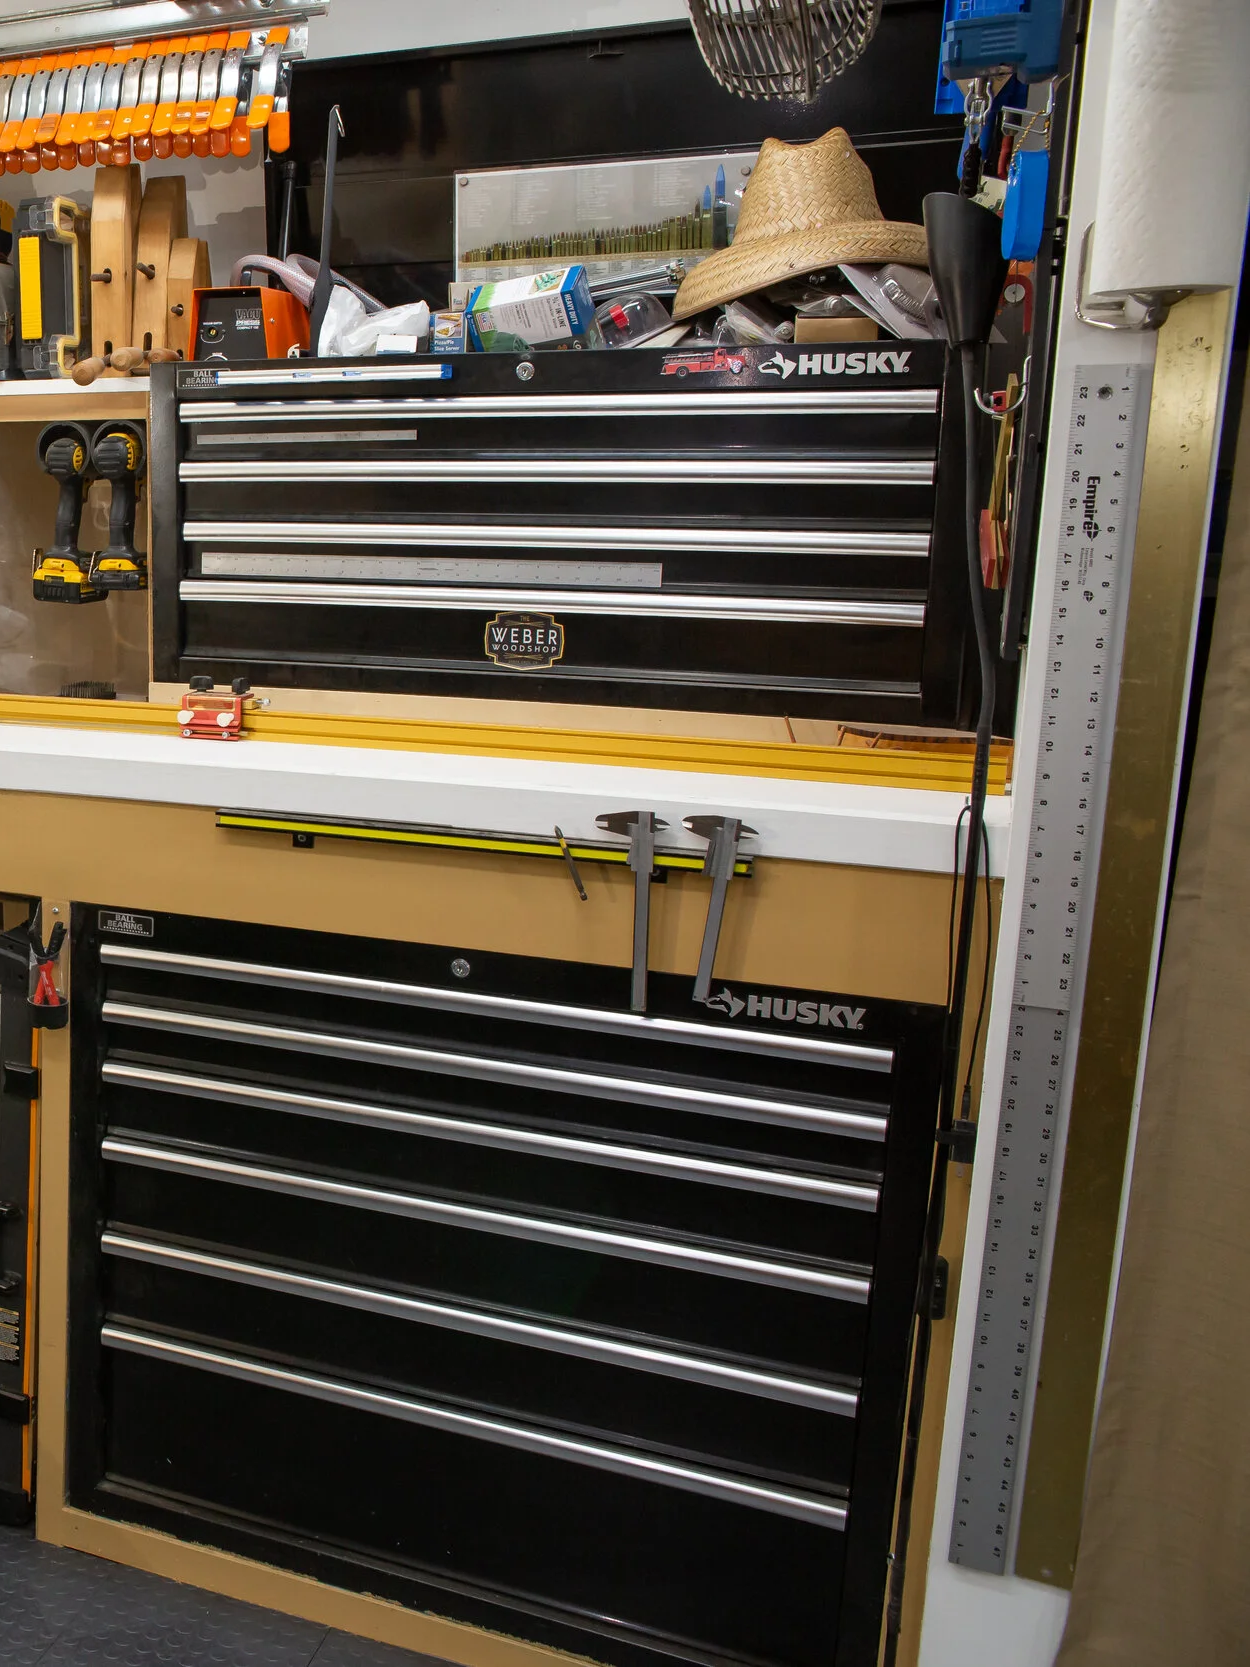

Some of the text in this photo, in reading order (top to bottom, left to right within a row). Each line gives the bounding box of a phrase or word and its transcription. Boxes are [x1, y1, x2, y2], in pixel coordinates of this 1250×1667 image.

[236, 308, 261, 319] VACU
[798, 352, 912, 375] HUSKY
[1079, 386, 1088, 399] 23
[1076, 414, 1086, 427] 22
[1074, 444, 1082, 455] 21
[1071, 470, 1080, 483] 20
[1069, 498, 1078, 510] 19
[1082, 476, 1101, 531] Empire
[1066, 526, 1075, 537] 18
[1064, 553, 1072, 564] 17
[1061, 580, 1070, 592] 16
[1058, 607, 1067, 619] 15
[492, 627, 557, 645] WEBER
[1056, 634, 1064, 646] 14
[492, 644, 557, 653] WOODSHOP
[1095, 637, 1104, 649] 10
[1053, 661, 1062, 672] 13
[1092, 664, 1101, 674] 11
[1050, 688, 1059, 699] 12
[1090, 692, 1098, 703] 12
[1048, 716, 1056, 726] 11
[1087, 718, 1096, 730] 13
[1045, 741, 1054, 752] 10
[1084, 745, 1093, 756] 14
[1082, 772, 1090, 782] 15
[1078, 798, 1087, 809] 16
[1076, 824, 1084, 835] 17
[1073, 851, 1082, 862] 18
[1070, 876, 1079, 888] 19
[1068, 901, 1076, 913] 20
[115, 914, 135, 924] BALL
[107, 919, 143, 931] BEARING
[1065, 927, 1074, 938] 21
[1062, 953, 1071, 964] 22
[1059, 978, 1068, 990] 23
[746, 995, 866, 1030] HUSKY
[1015, 1025, 1024, 1037] 23
[1053, 1029, 1062, 1041] 25
[1012, 1050, 1021, 1062] 22
[1050, 1054, 1060, 1066] 26
[1010, 1075, 1018, 1086] 21
[1048, 1079, 1056, 1091] 27
[1007, 1098, 1016, 1110] 20
[1045, 1104, 1054, 1115] 28
[1005, 1123, 1012, 1133] 19
[1042, 1128, 1050, 1140] 29
[1002, 1147, 1010, 1157] 18
[1039, 1152, 1048, 1164] 30
[999, 1171, 1007, 1181] 17
[1037, 1177, 1045, 1187] 31
[996, 1195, 1004, 1205] 16
[1033, 1200, 1042, 1212] 32
[994, 1219, 1002, 1228] 15
[1030, 1225, 1039, 1236] 33
[991, 1242, 998, 1252] 14
[1028, 1248, 1036, 1260] 34
[988, 1266, 996, 1276] 13
[1025, 1272, 1034, 1283] 35
[986, 1289, 994, 1298] 12
[1022, 1296, 1031, 1307] 36
[983, 1313, 990, 1322] 11
[1020, 1319, 1028, 1331] 37
[980, 1335, 988, 1345] 10
[1016, 1342, 1025, 1354] 38
[1014, 1366, 1022, 1377] 39
[1011, 1388, 1020, 1400] 40
[1008, 1412, 1017, 1422] 41
[1006, 1434, 1014, 1446] 42
[1003, 1457, 1011, 1468] 43
[1000, 1480, 1008, 1490] 44
[998, 1502, 1006, 1513] 45
[995, 1524, 1004, 1535] 46
[993, 1547, 1001, 1558] 47
